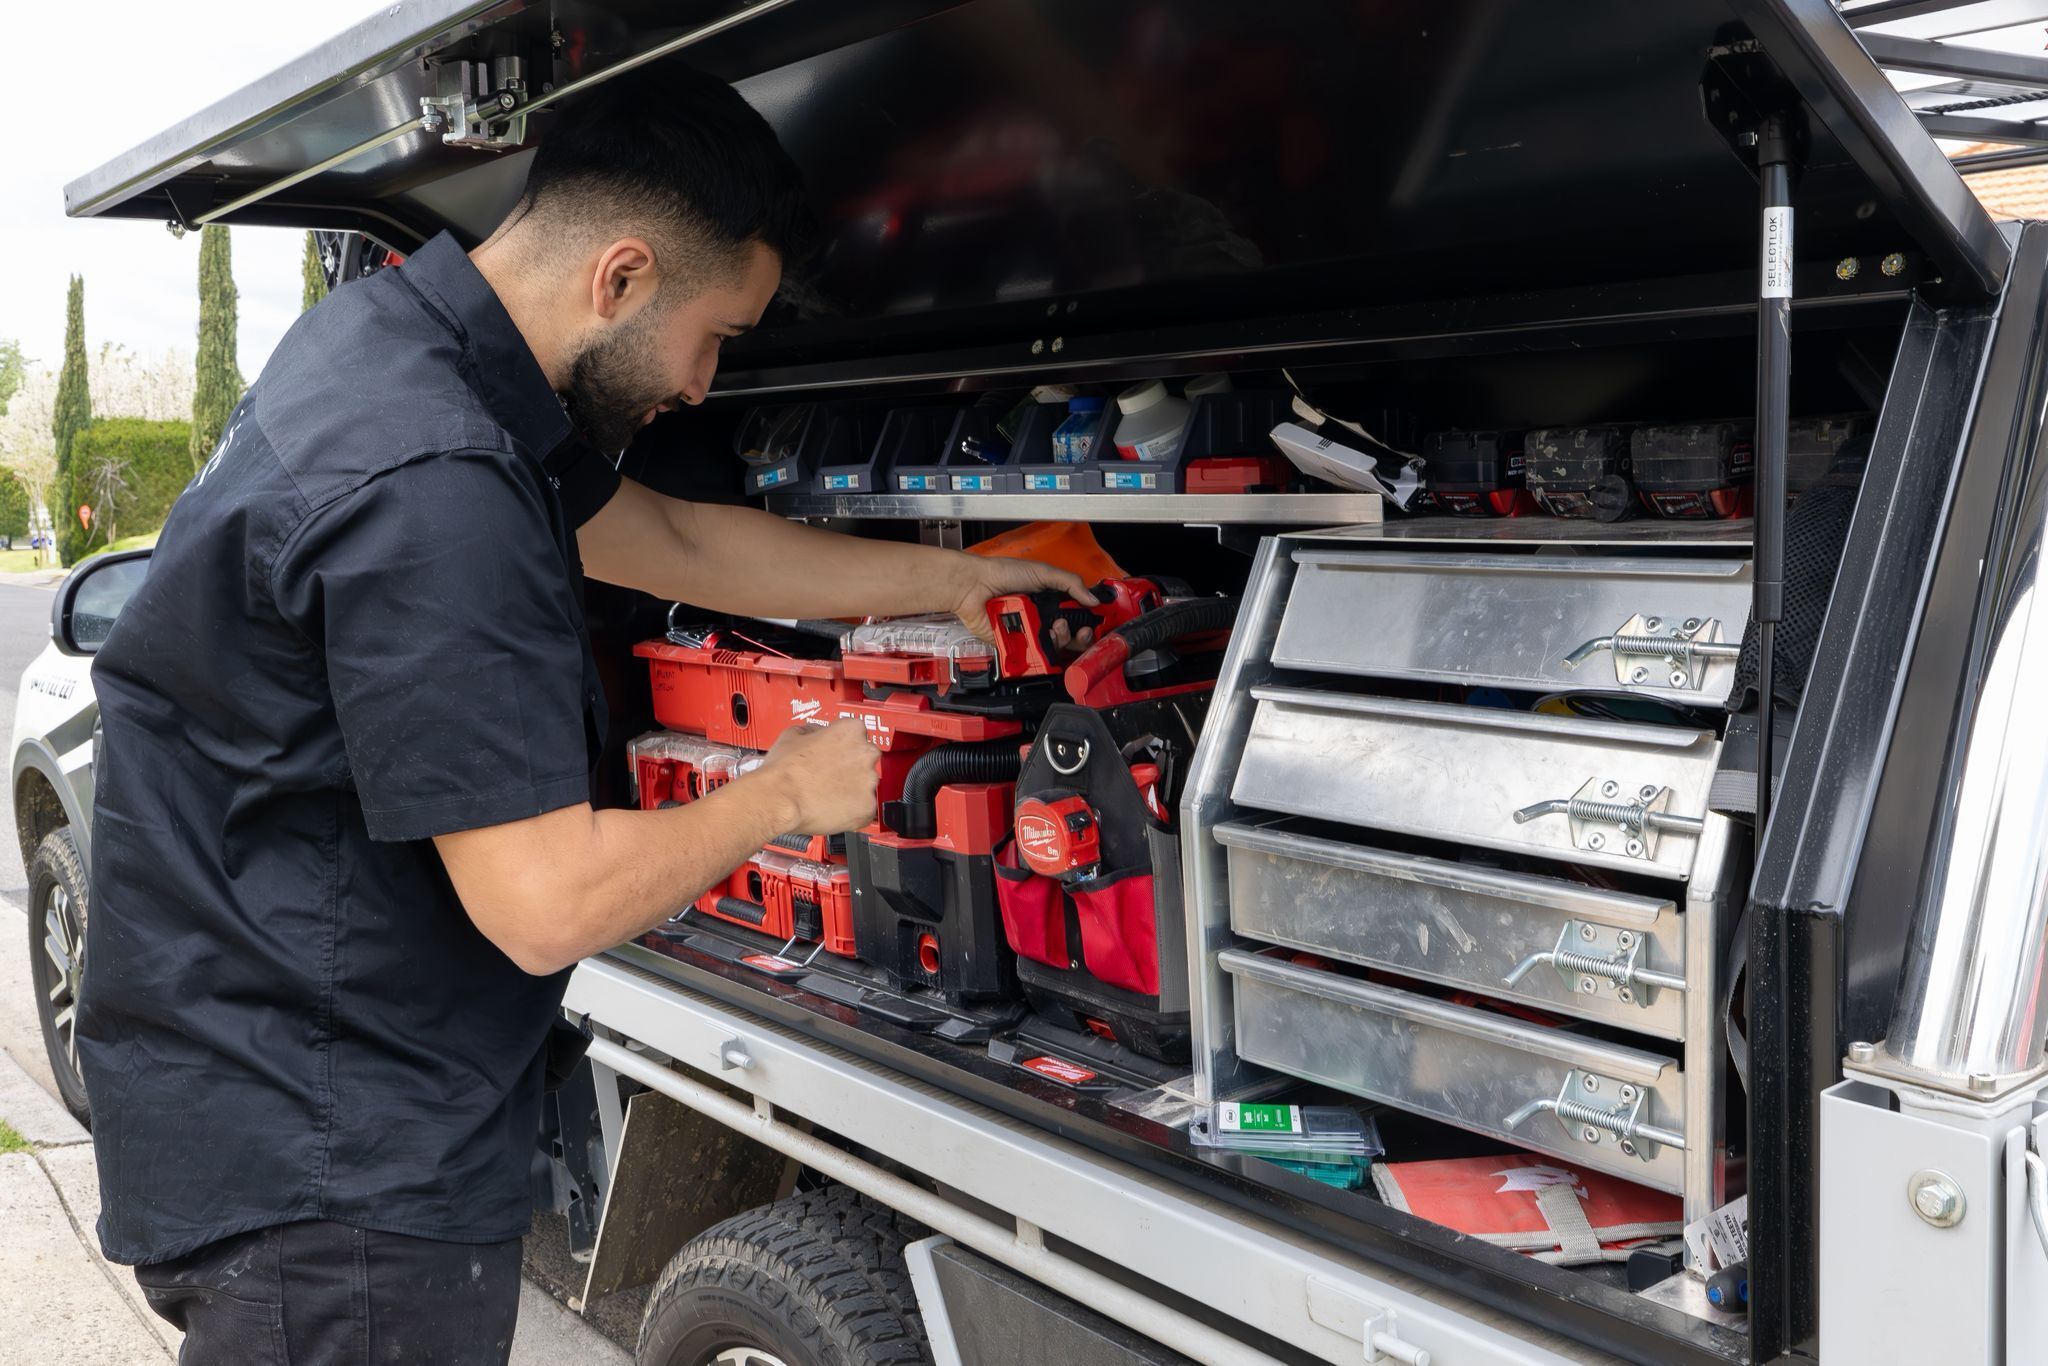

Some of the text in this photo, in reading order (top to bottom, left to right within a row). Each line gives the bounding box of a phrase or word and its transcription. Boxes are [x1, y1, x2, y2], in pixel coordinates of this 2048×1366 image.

[1767, 216, 1778, 288] SELECTLOK
[1022, 821, 1057, 840] Milwaukee
[1724, 1213, 1737, 1238] TEETH
